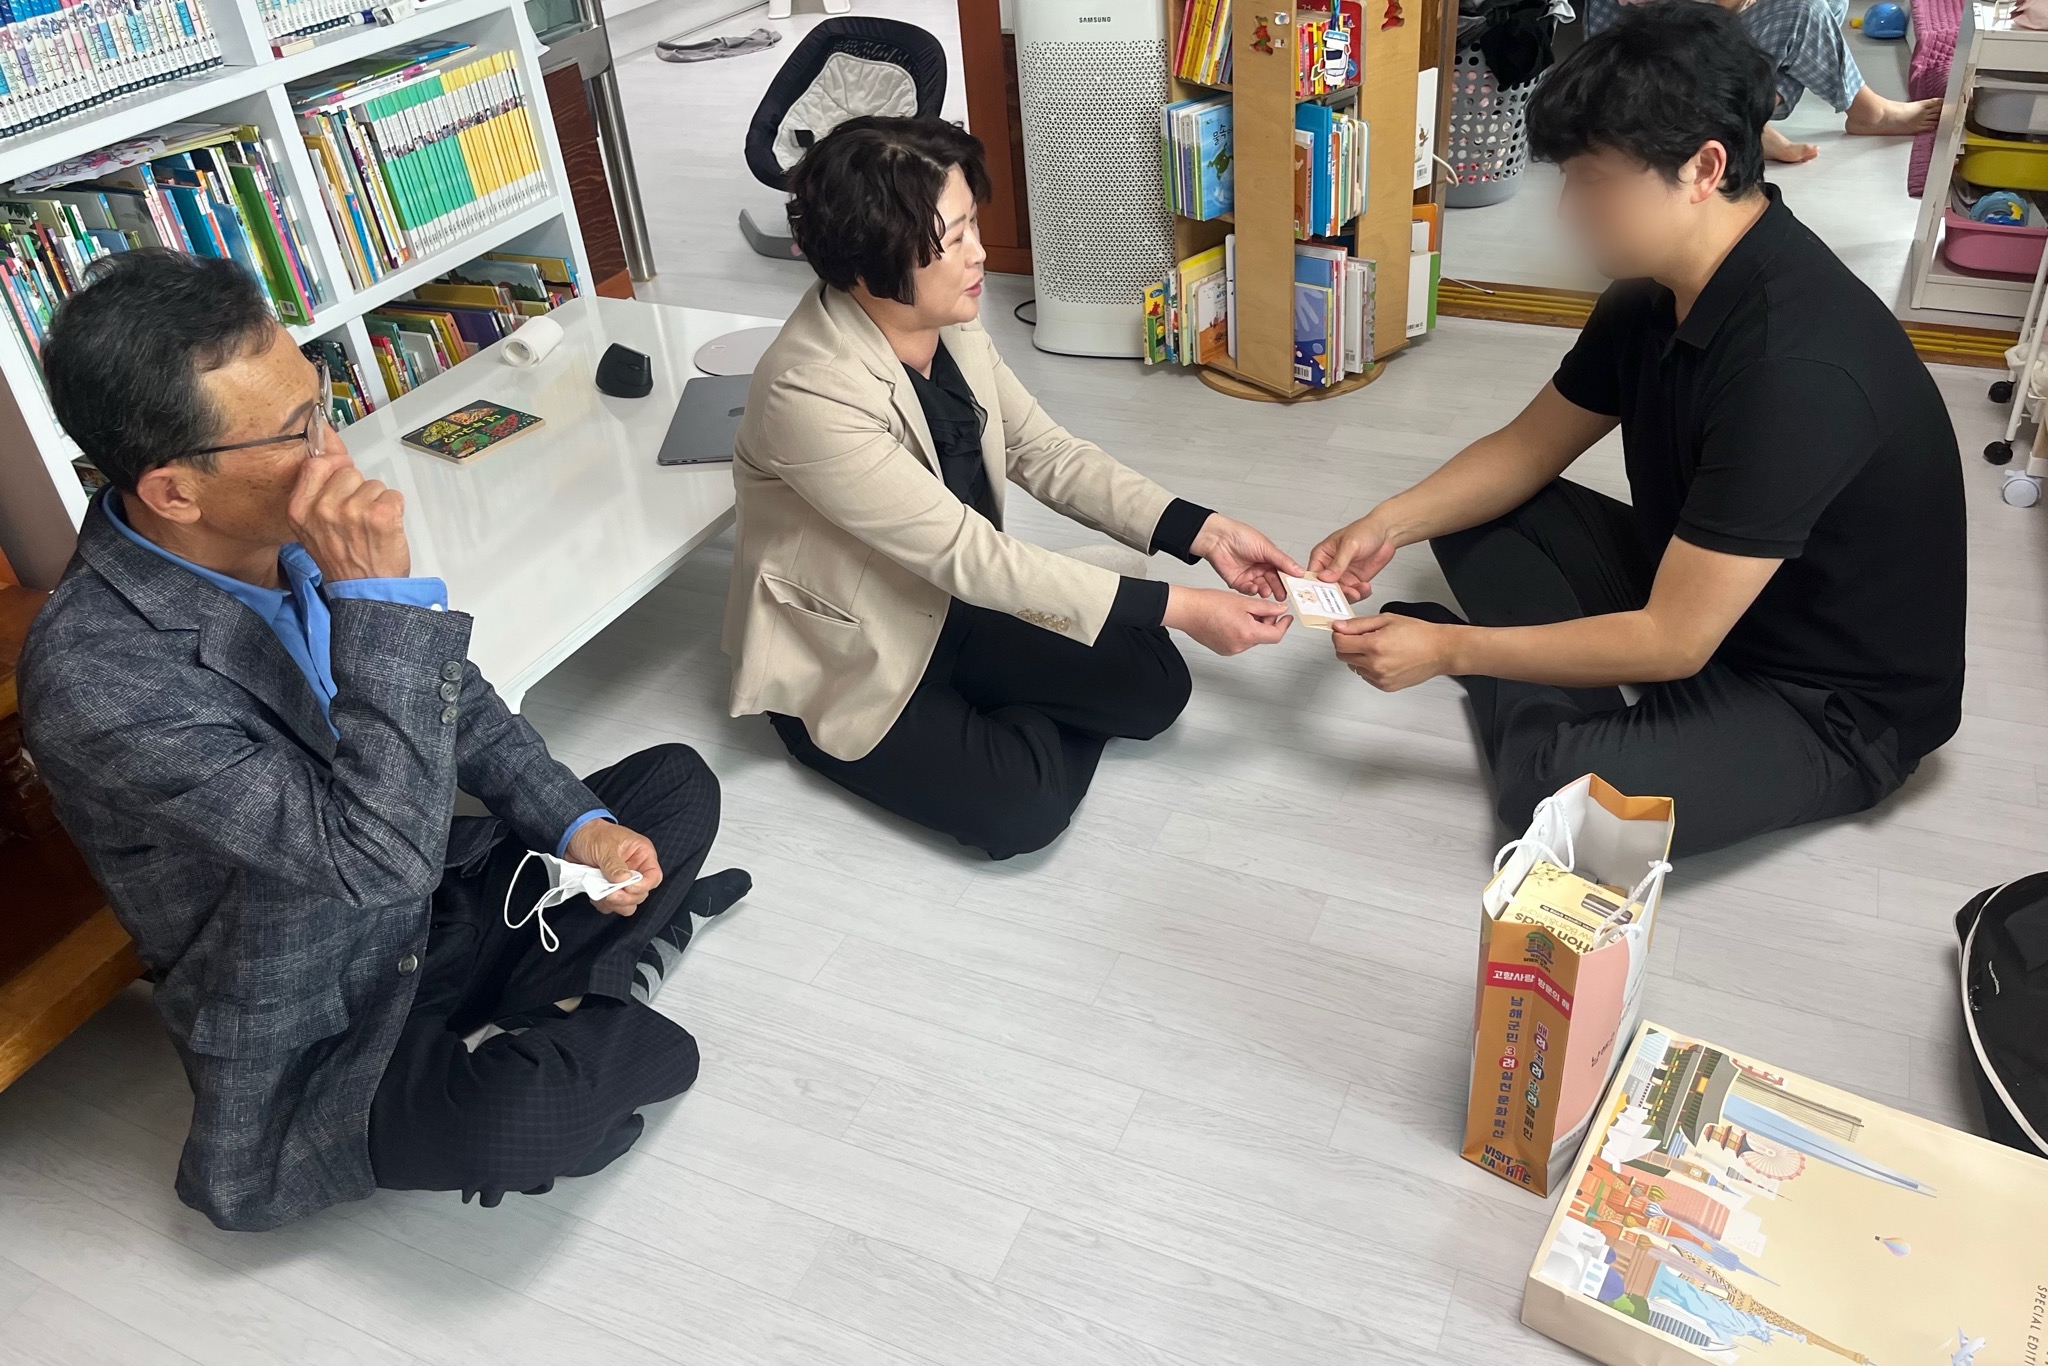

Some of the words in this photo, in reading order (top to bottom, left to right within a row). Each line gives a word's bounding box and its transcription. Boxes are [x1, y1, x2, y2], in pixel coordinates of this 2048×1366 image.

[1492, 970, 1535, 983] 고향사랑
[1537, 977, 1560, 1002] 방문의
[1506, 996, 1524, 1044] 남해군민
[1484, 1144, 1514, 1166] VISIT
[2030, 1284, 2048, 1331] SPECIAL
[2024, 1334, 2040, 1366] EDITI
